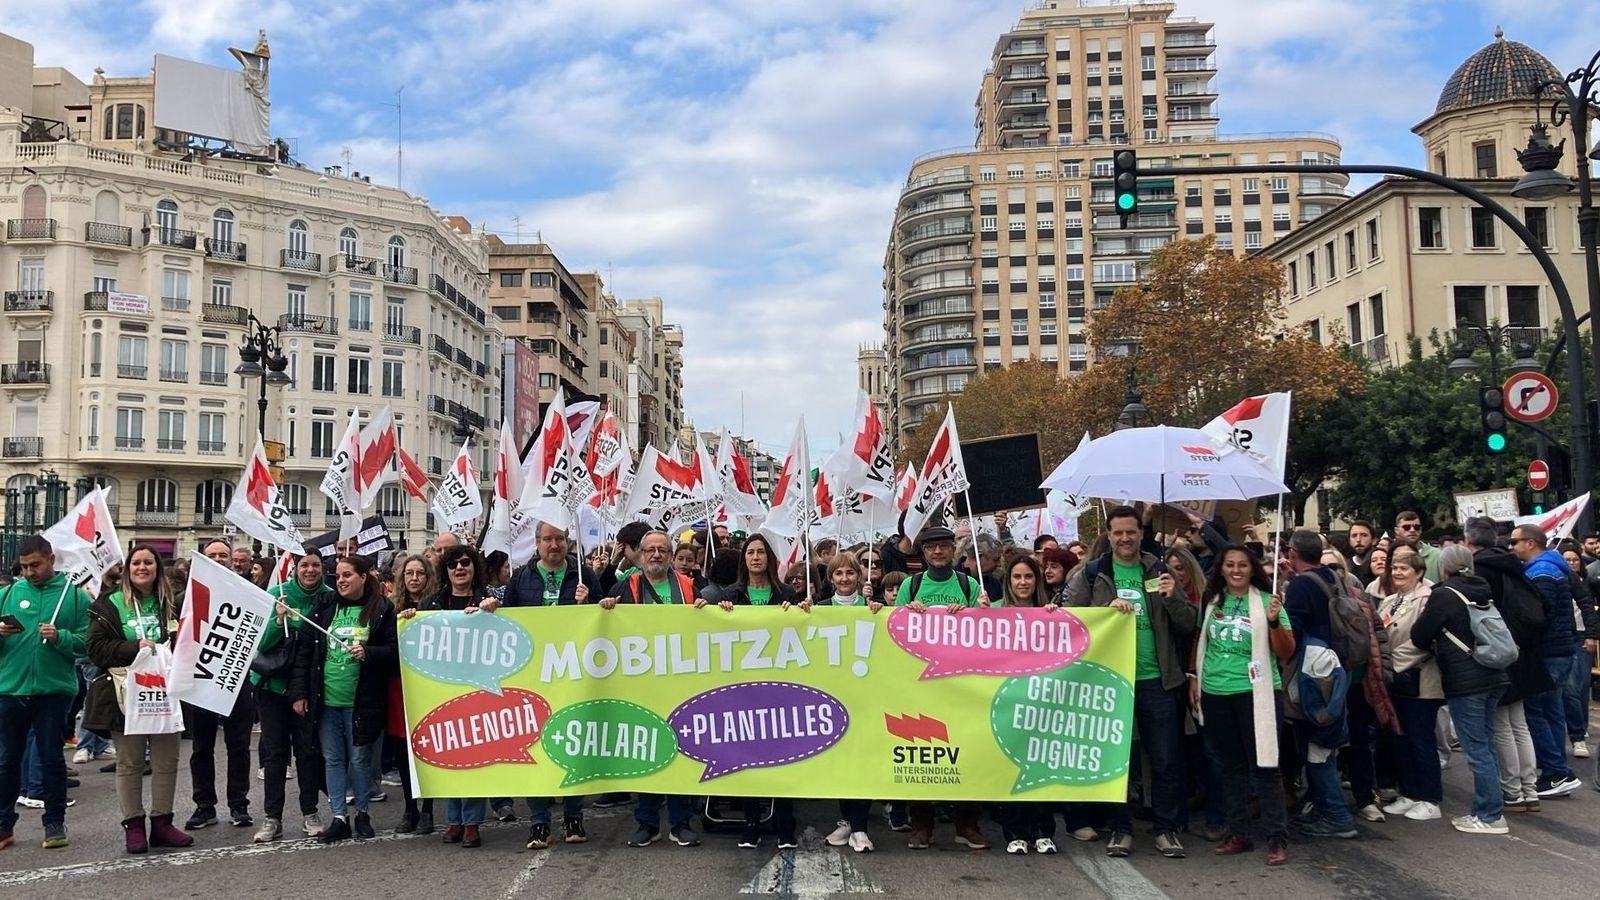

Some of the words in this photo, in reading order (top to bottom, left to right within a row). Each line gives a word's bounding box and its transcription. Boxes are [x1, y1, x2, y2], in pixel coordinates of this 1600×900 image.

[406, 617, 518, 668] -RÀTIOS
[896, 612, 1073, 654] -BUROCRÀCIA
[1027, 675, 1117, 713] CENTRES
[418, 698, 539, 754] +VALENCIÀ
[551, 719, 658, 763] +SALARI
[679, 703, 834, 745] +PLANTILLES
[1012, 703, 1124, 746] EDUCATIUS
[893, 745, 960, 765] STEPV
[893, 765, 960, 776] INTERSINDICAL
[1026, 736, 1102, 773] DIGNES
[905, 775, 961, 785] VALENCIANA
